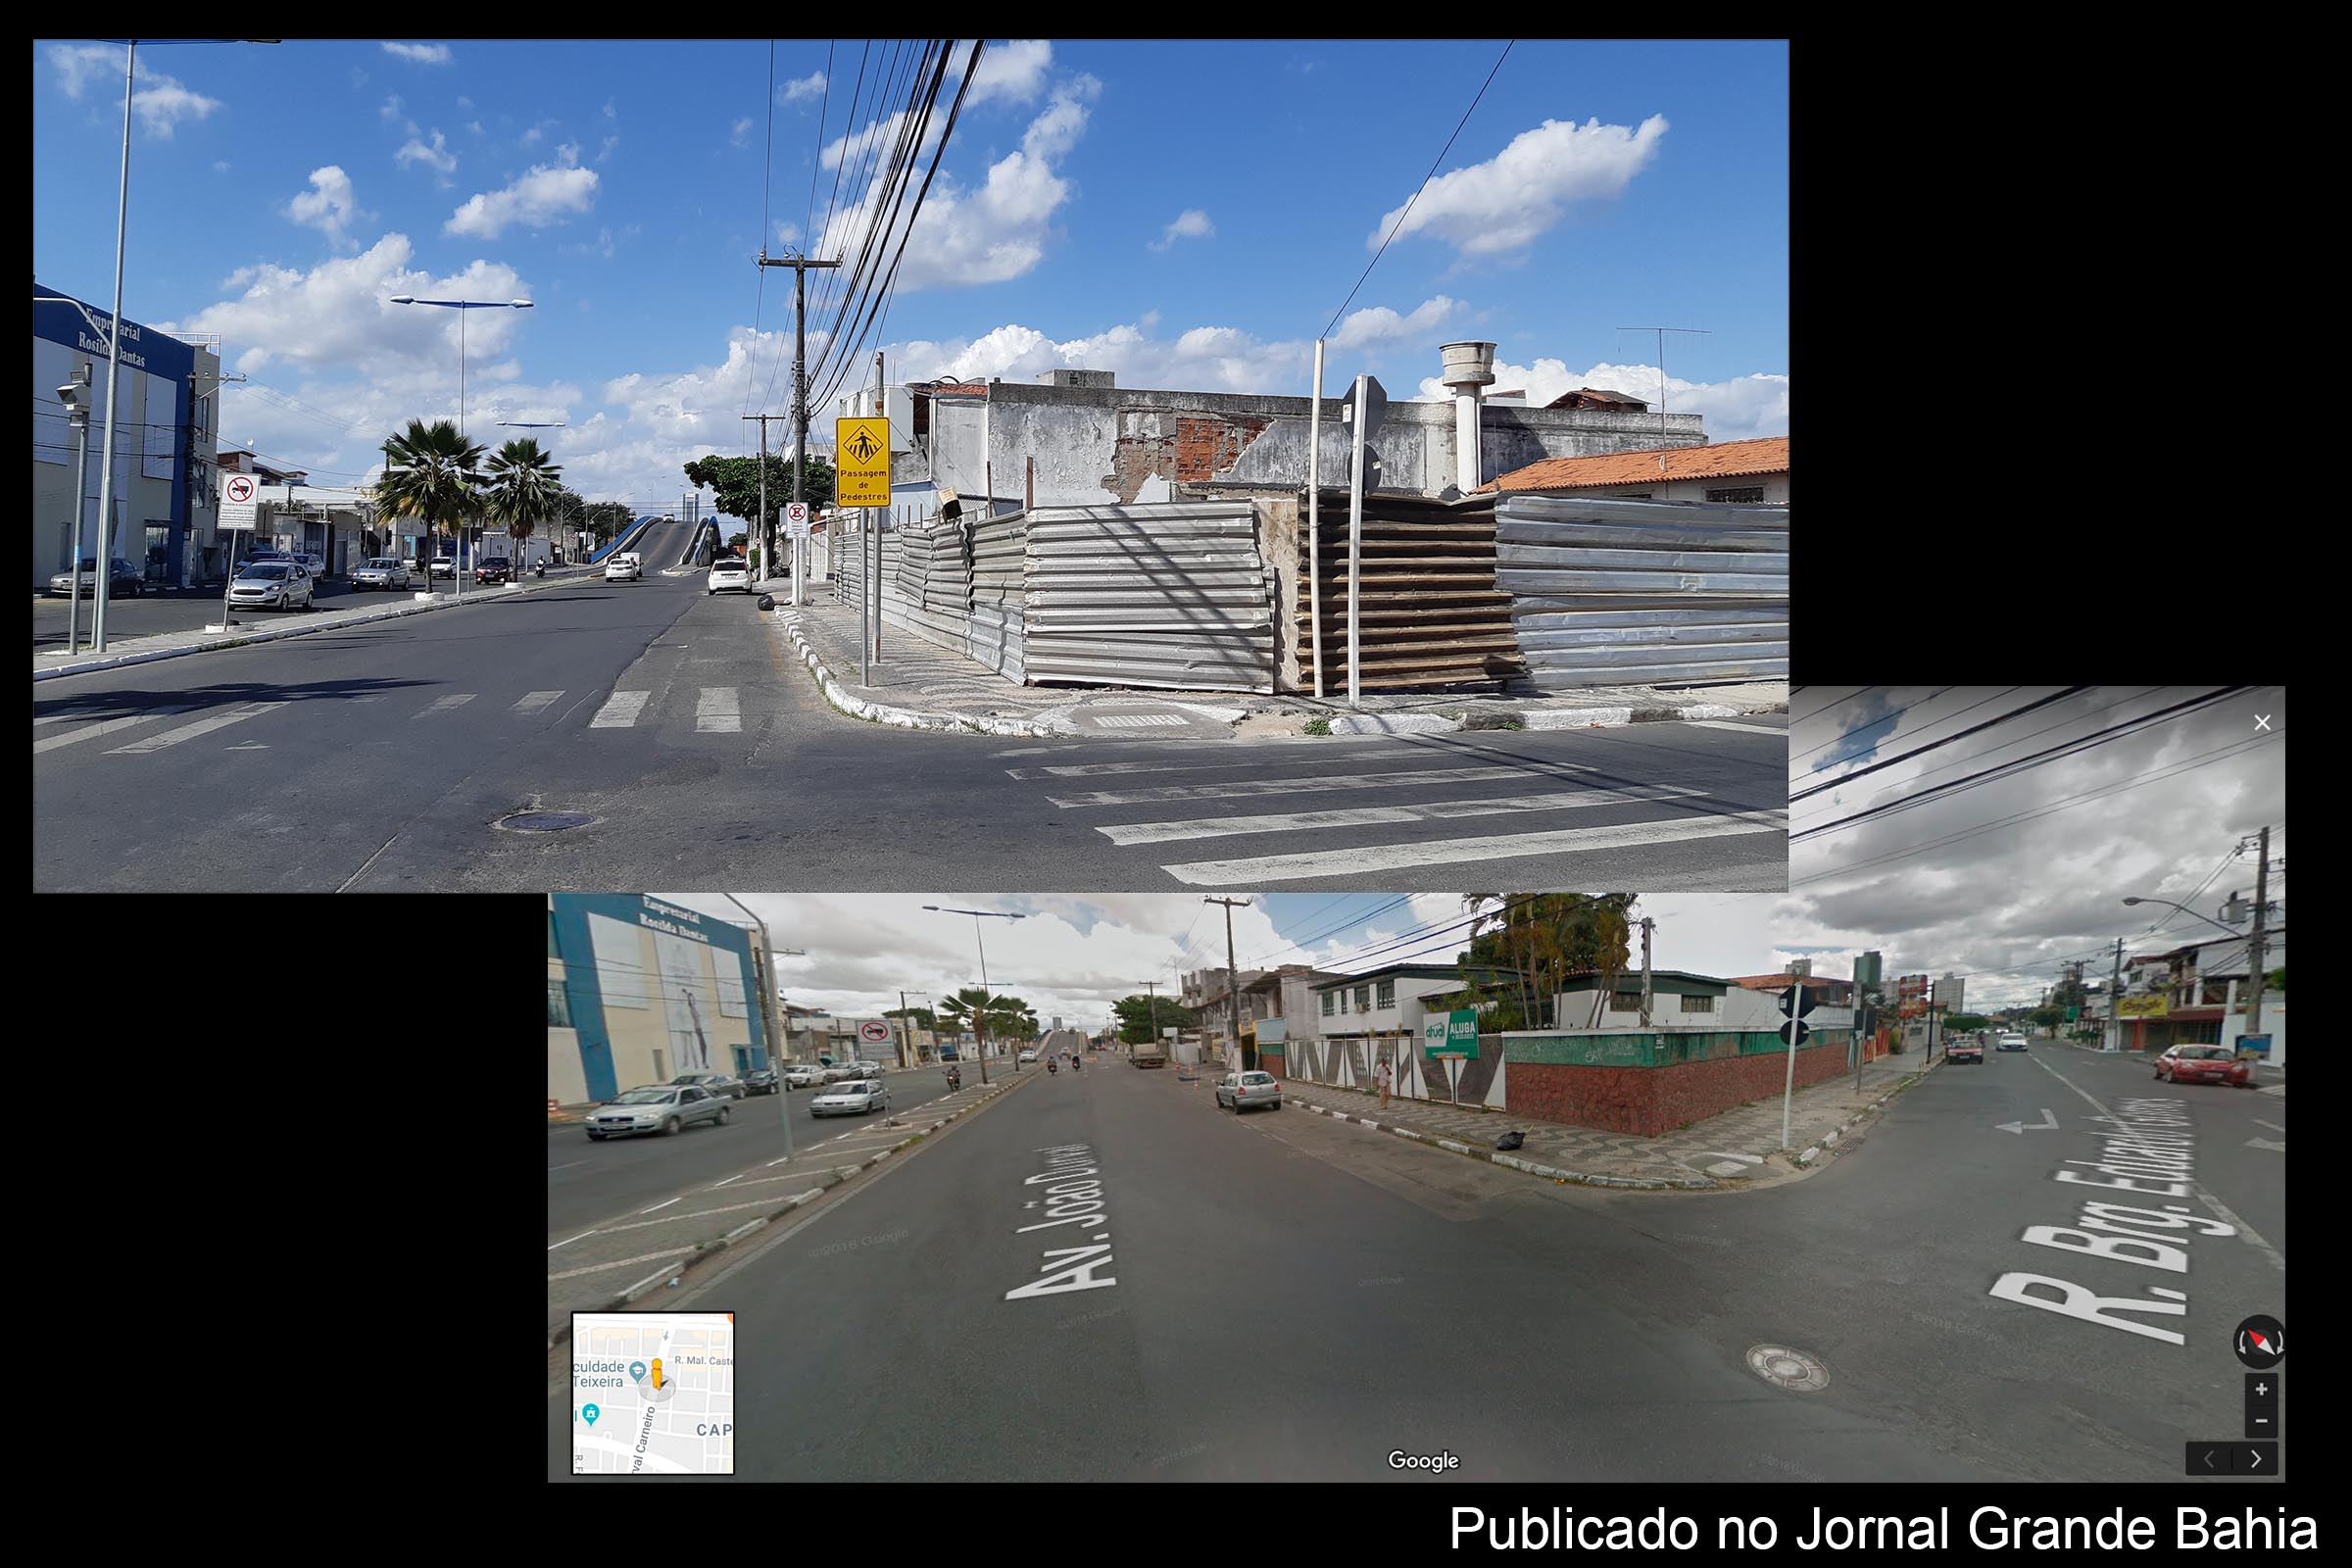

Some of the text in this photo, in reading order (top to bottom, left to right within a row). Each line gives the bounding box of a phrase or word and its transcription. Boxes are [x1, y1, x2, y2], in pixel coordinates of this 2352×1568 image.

[85, 308, 140, 341] Emprarial
[840, 469, 887, 478] Passagem
[1450, 1021, 1476, 1034] ALUGA
